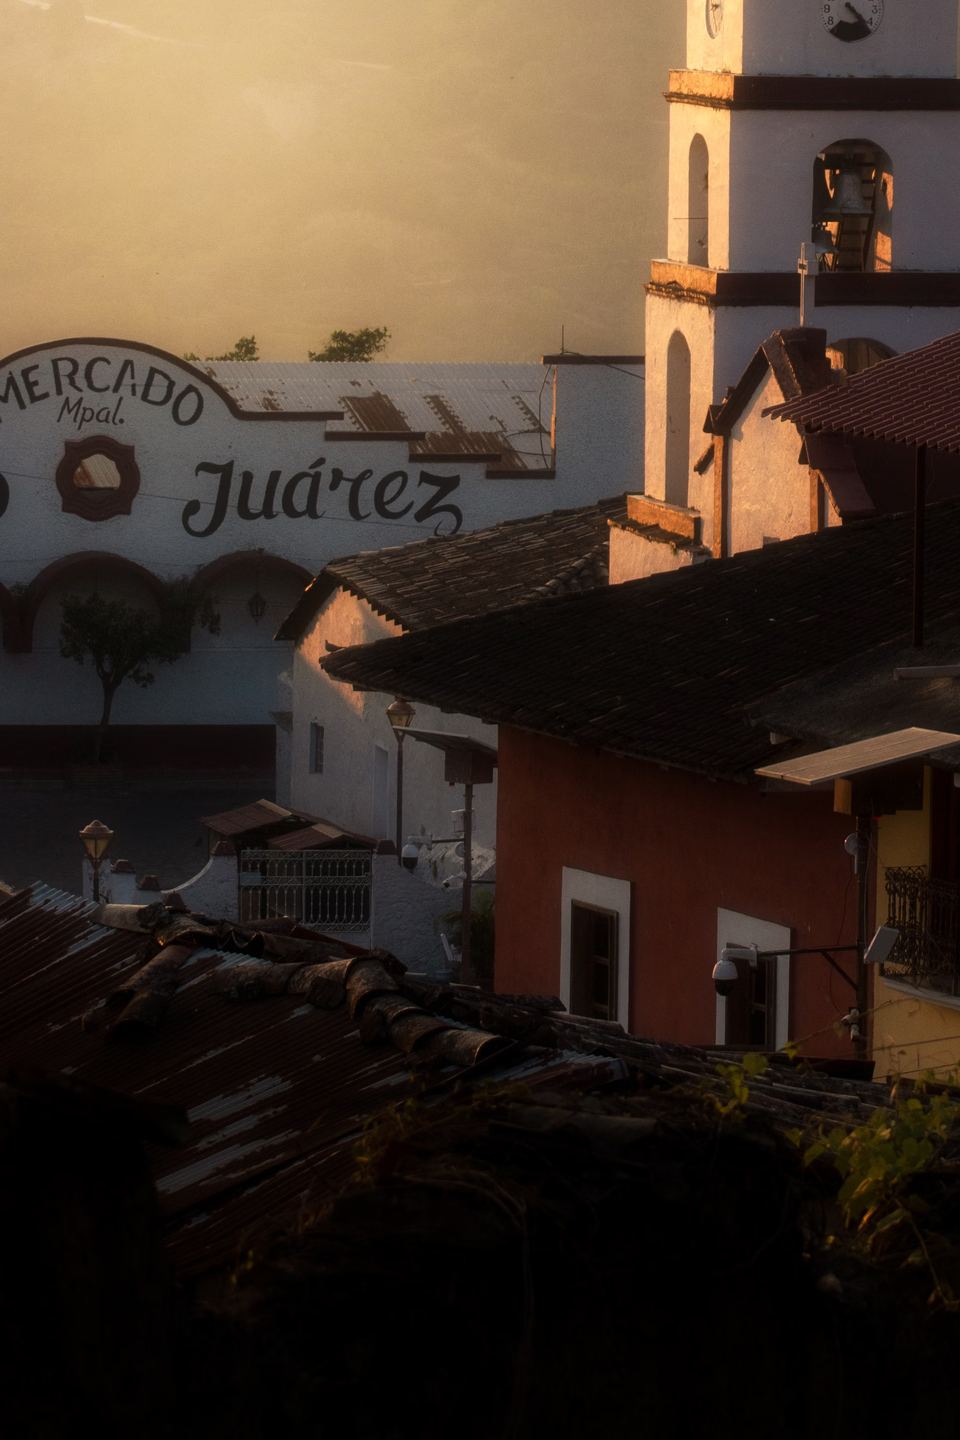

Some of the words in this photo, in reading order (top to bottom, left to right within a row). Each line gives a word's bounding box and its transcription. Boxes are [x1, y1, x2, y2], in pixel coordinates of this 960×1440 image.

[823, 4, 830, 13] 9
[872, 5, 878, 14] 3
[827, 16, 834, 25] 8
[866, 17, 873, 26] 4
[57, 396, 125, 430] Mpal.
[181, 457, 464, 537] Juárez
